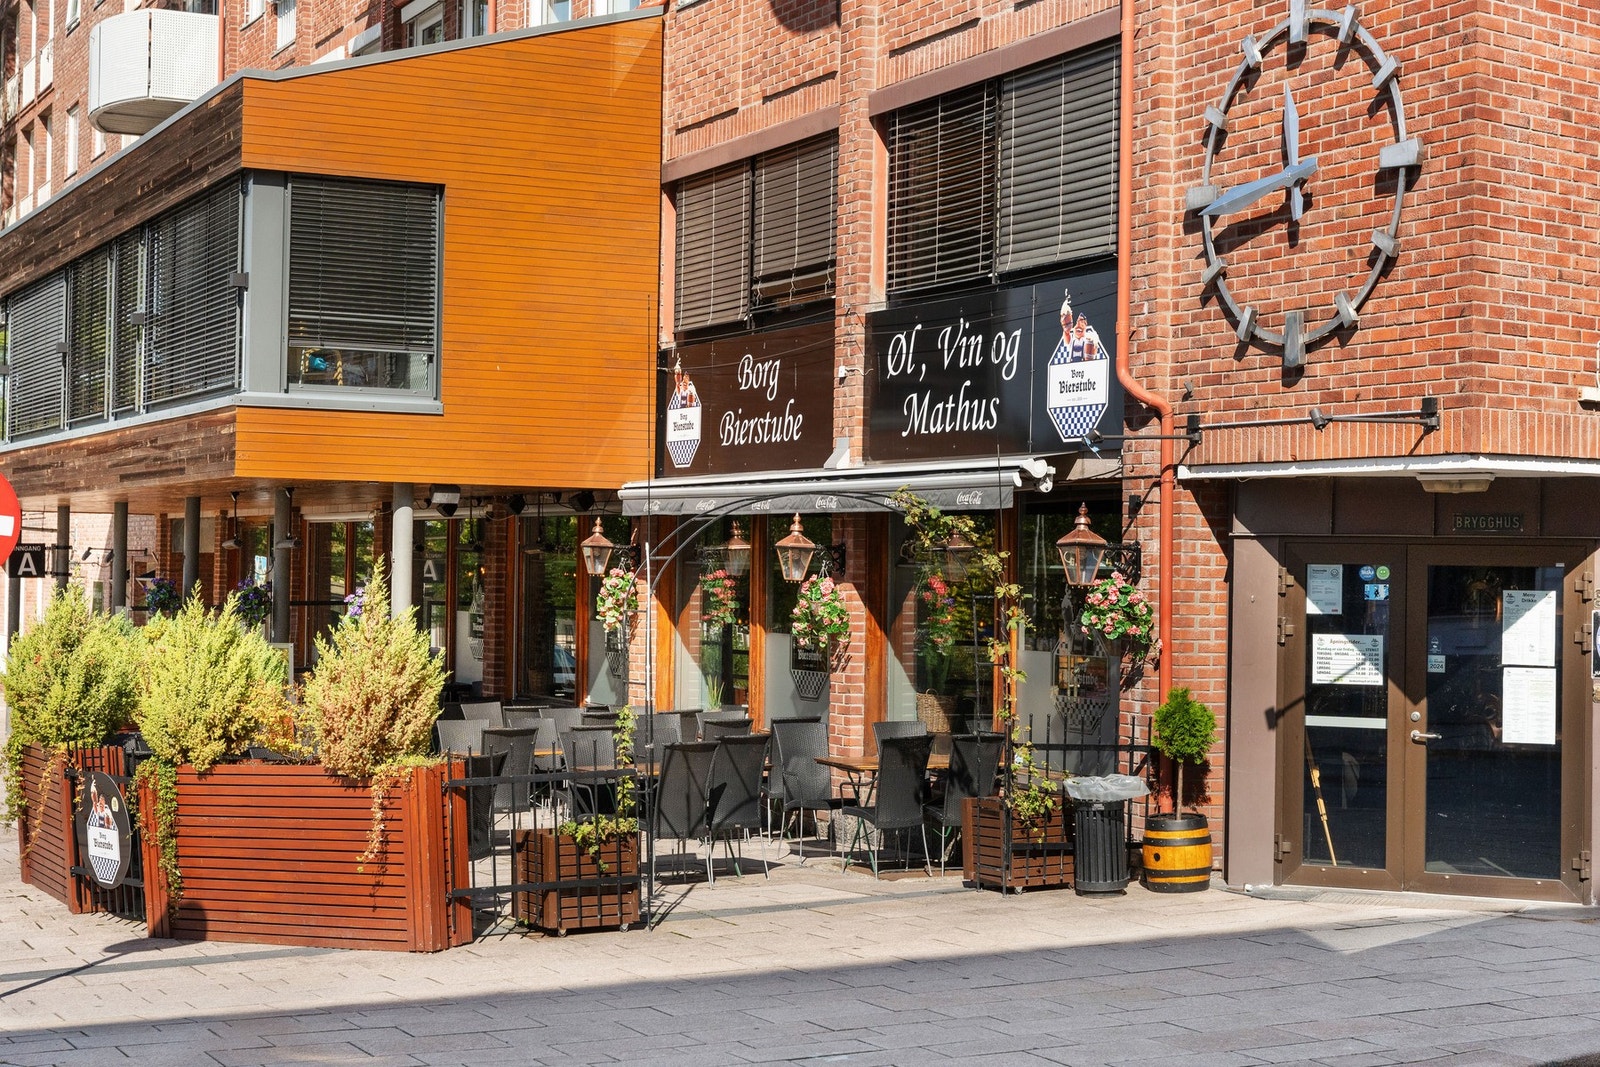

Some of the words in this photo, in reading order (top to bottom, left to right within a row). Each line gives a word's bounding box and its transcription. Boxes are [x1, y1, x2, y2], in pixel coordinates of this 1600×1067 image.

[887, 324, 926, 382] Øl,
[938, 317, 983, 370] Vin
[991, 328, 1022, 381] og
[738, 354, 781, 401] Borg
[1059, 379, 1096, 394] Bierstube
[1071, 369, 1084, 379] Borg
[719, 398, 803, 446] Bierstube
[902, 380, 999, 437] Mathus
[1456, 516, 1520, 529] BRYGGHUS
[17, 552, 37, 576] A
